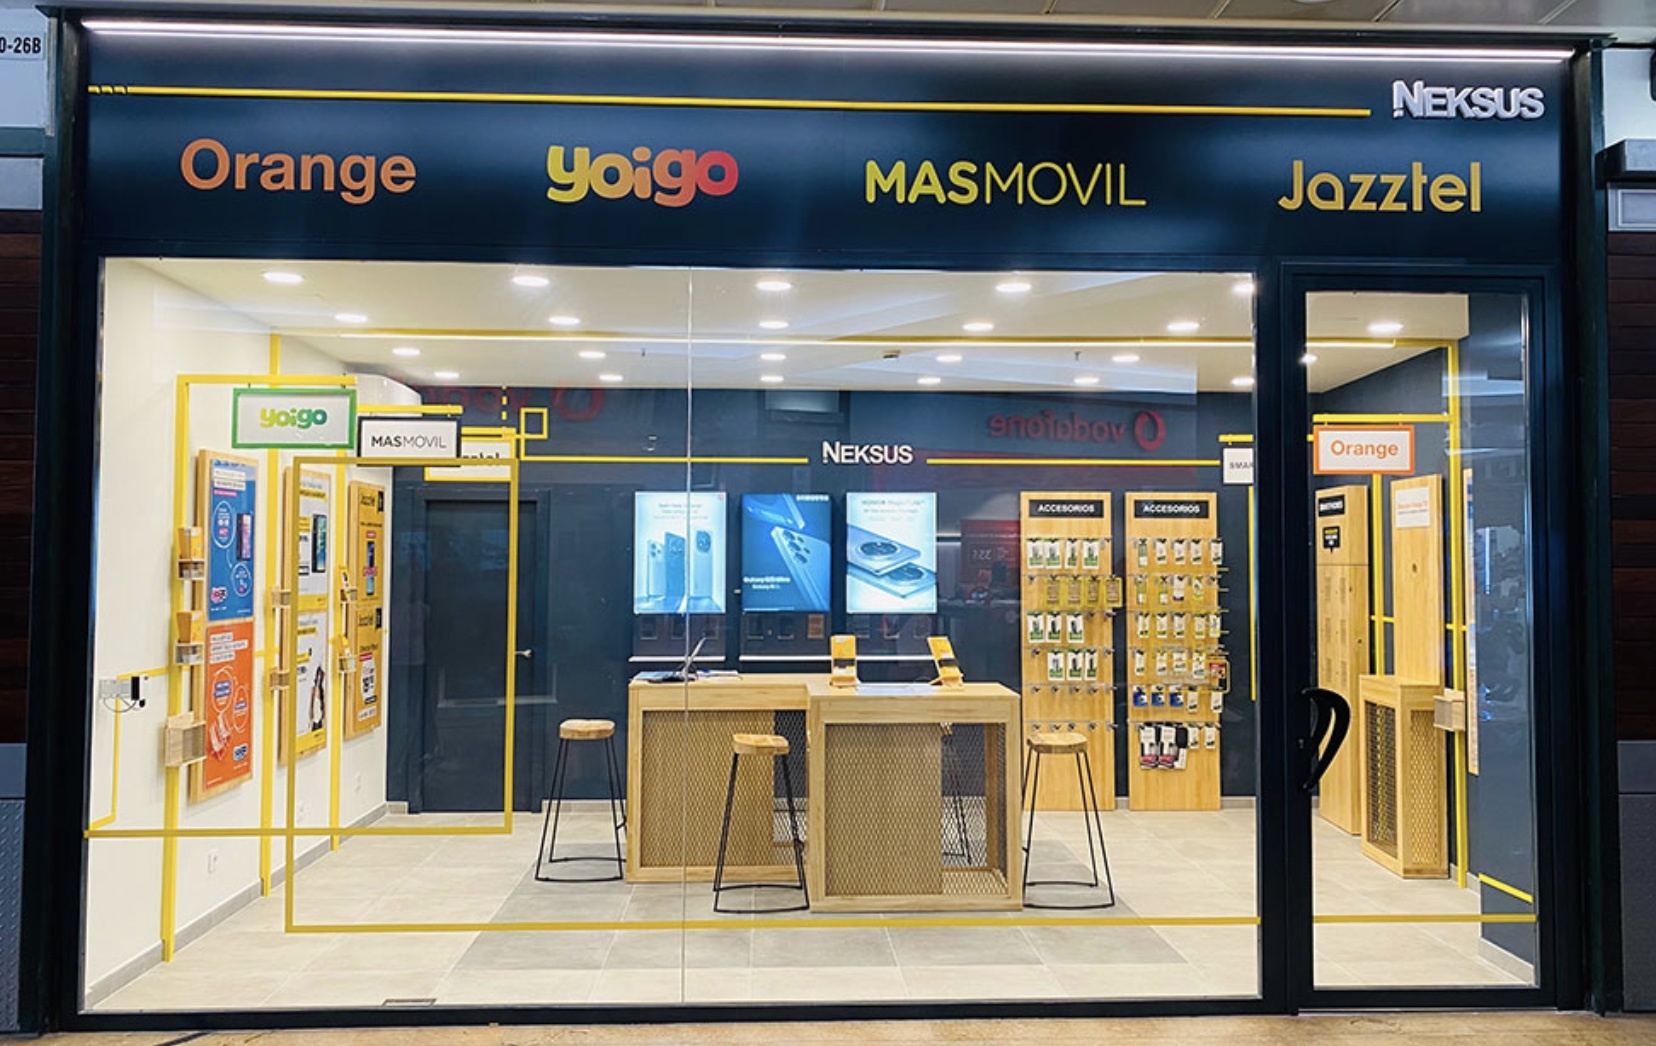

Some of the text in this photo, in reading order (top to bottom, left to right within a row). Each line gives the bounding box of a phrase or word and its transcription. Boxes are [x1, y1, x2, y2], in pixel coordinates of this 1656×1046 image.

[1392, 79, 1545, 120] NEKSUS
[180, 138, 417, 205] Orange
[546, 145, 739, 208] yoigo
[865, 159, 1147, 208] MASMOVIL
[1278, 160, 1483, 214] Jazztel
[259, 407, 327, 430] yoigo
[371, 434, 447, 449] MASMOVIL
[822, 440, 914, 465] NEKSUS
[1330, 439, 1399, 460] Orange
[1037, 503, 1095, 514] ACCESORIOS
[1142, 503, 1200, 514] ACCESORIOS
